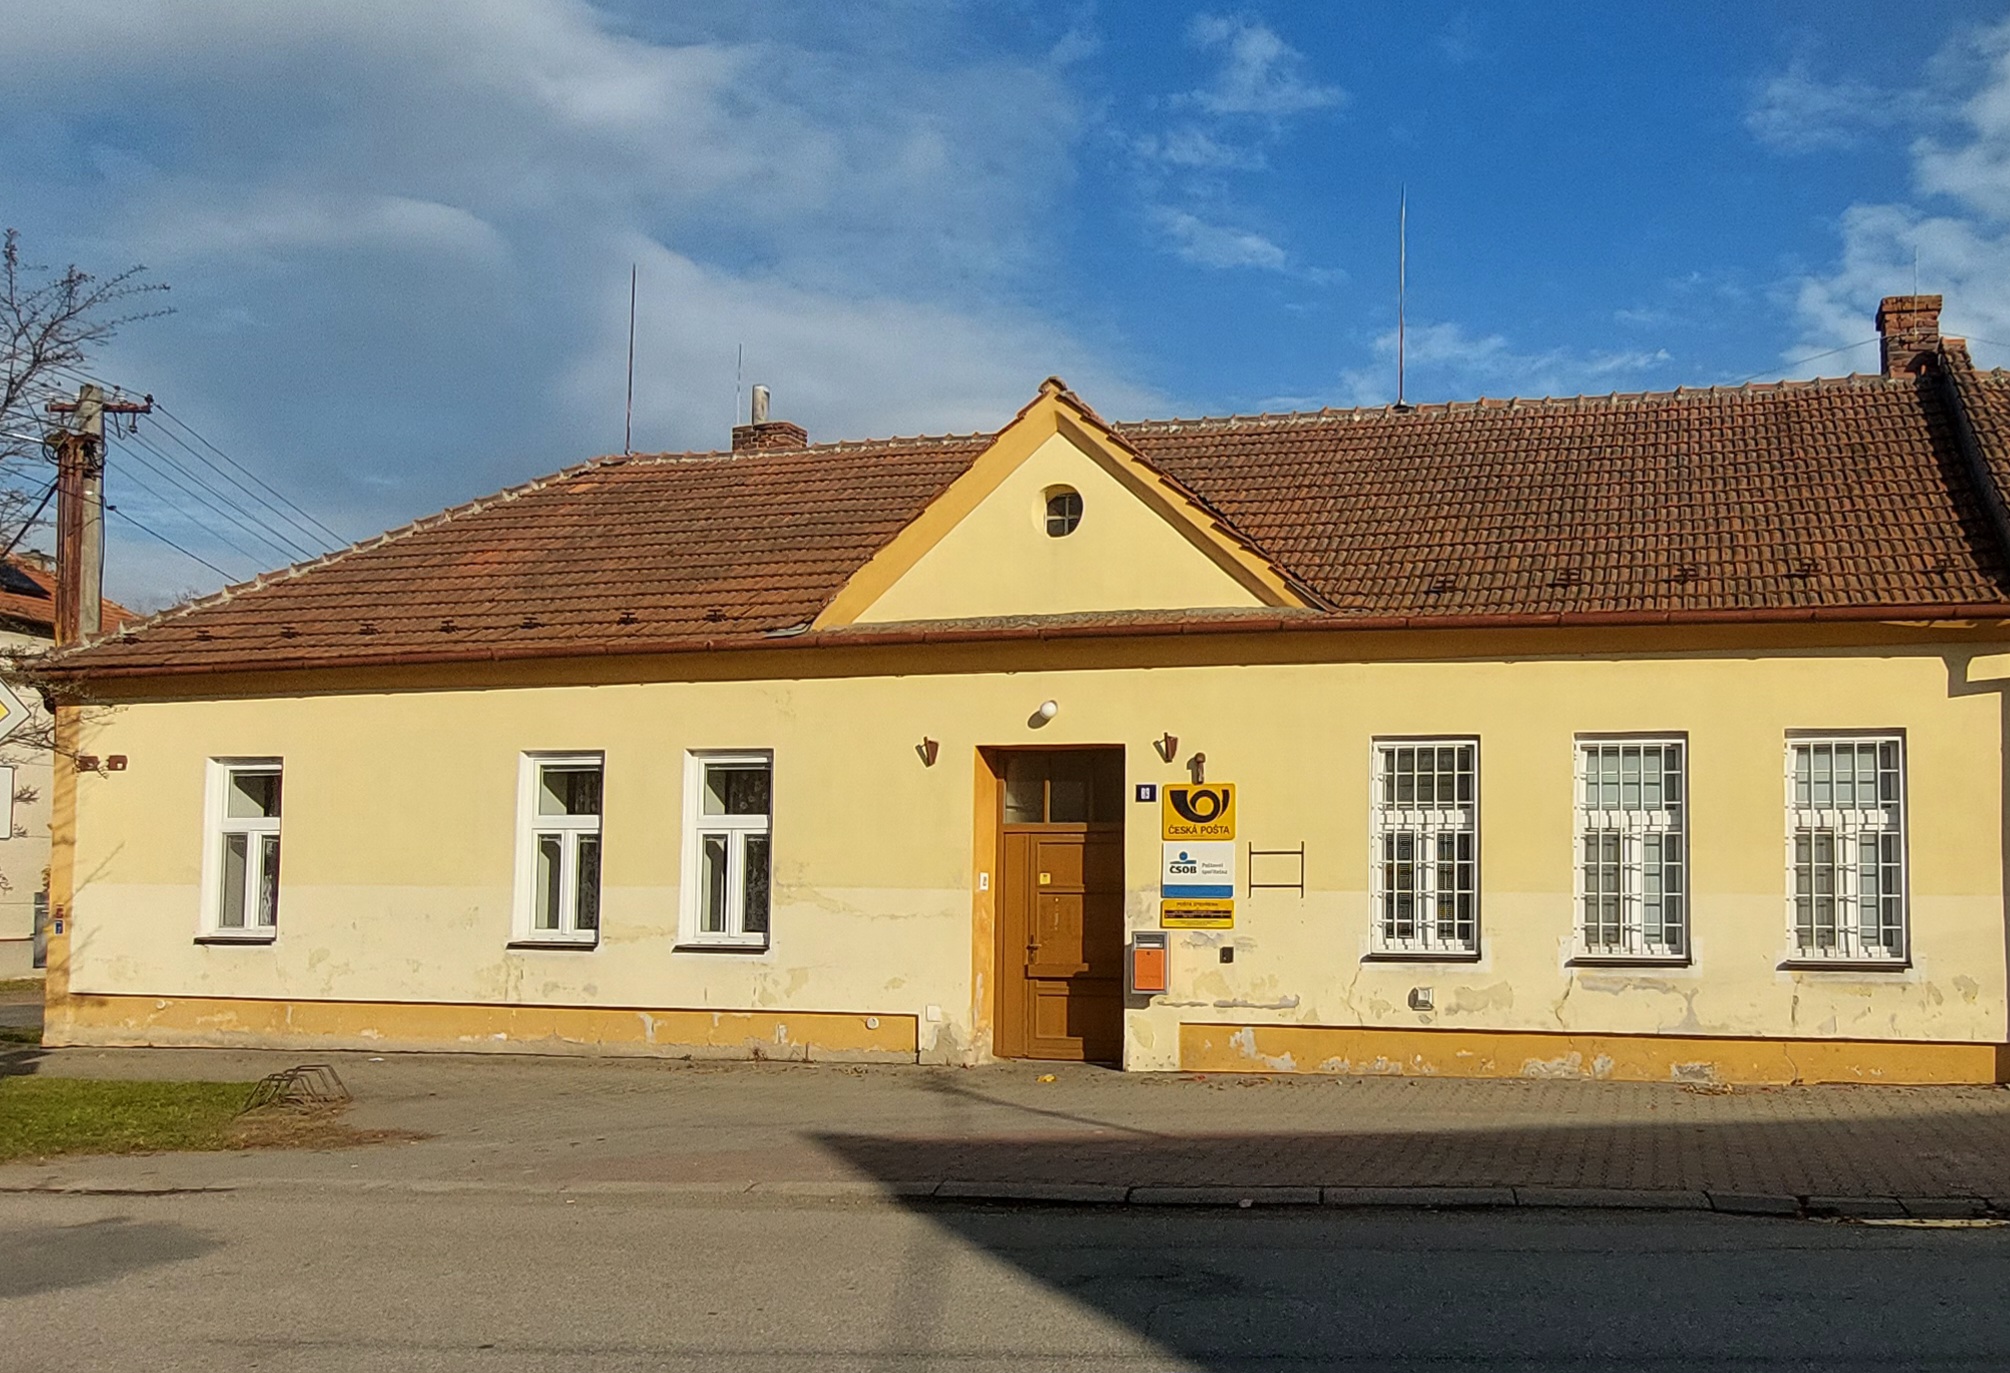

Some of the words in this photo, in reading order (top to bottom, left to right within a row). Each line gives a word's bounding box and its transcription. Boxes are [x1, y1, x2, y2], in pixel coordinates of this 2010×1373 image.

[1168, 824, 1198, 834] ČESKÁ
[1200, 824, 1230, 834] POŠTA
[1169, 865, 1197, 874] ČSOB
